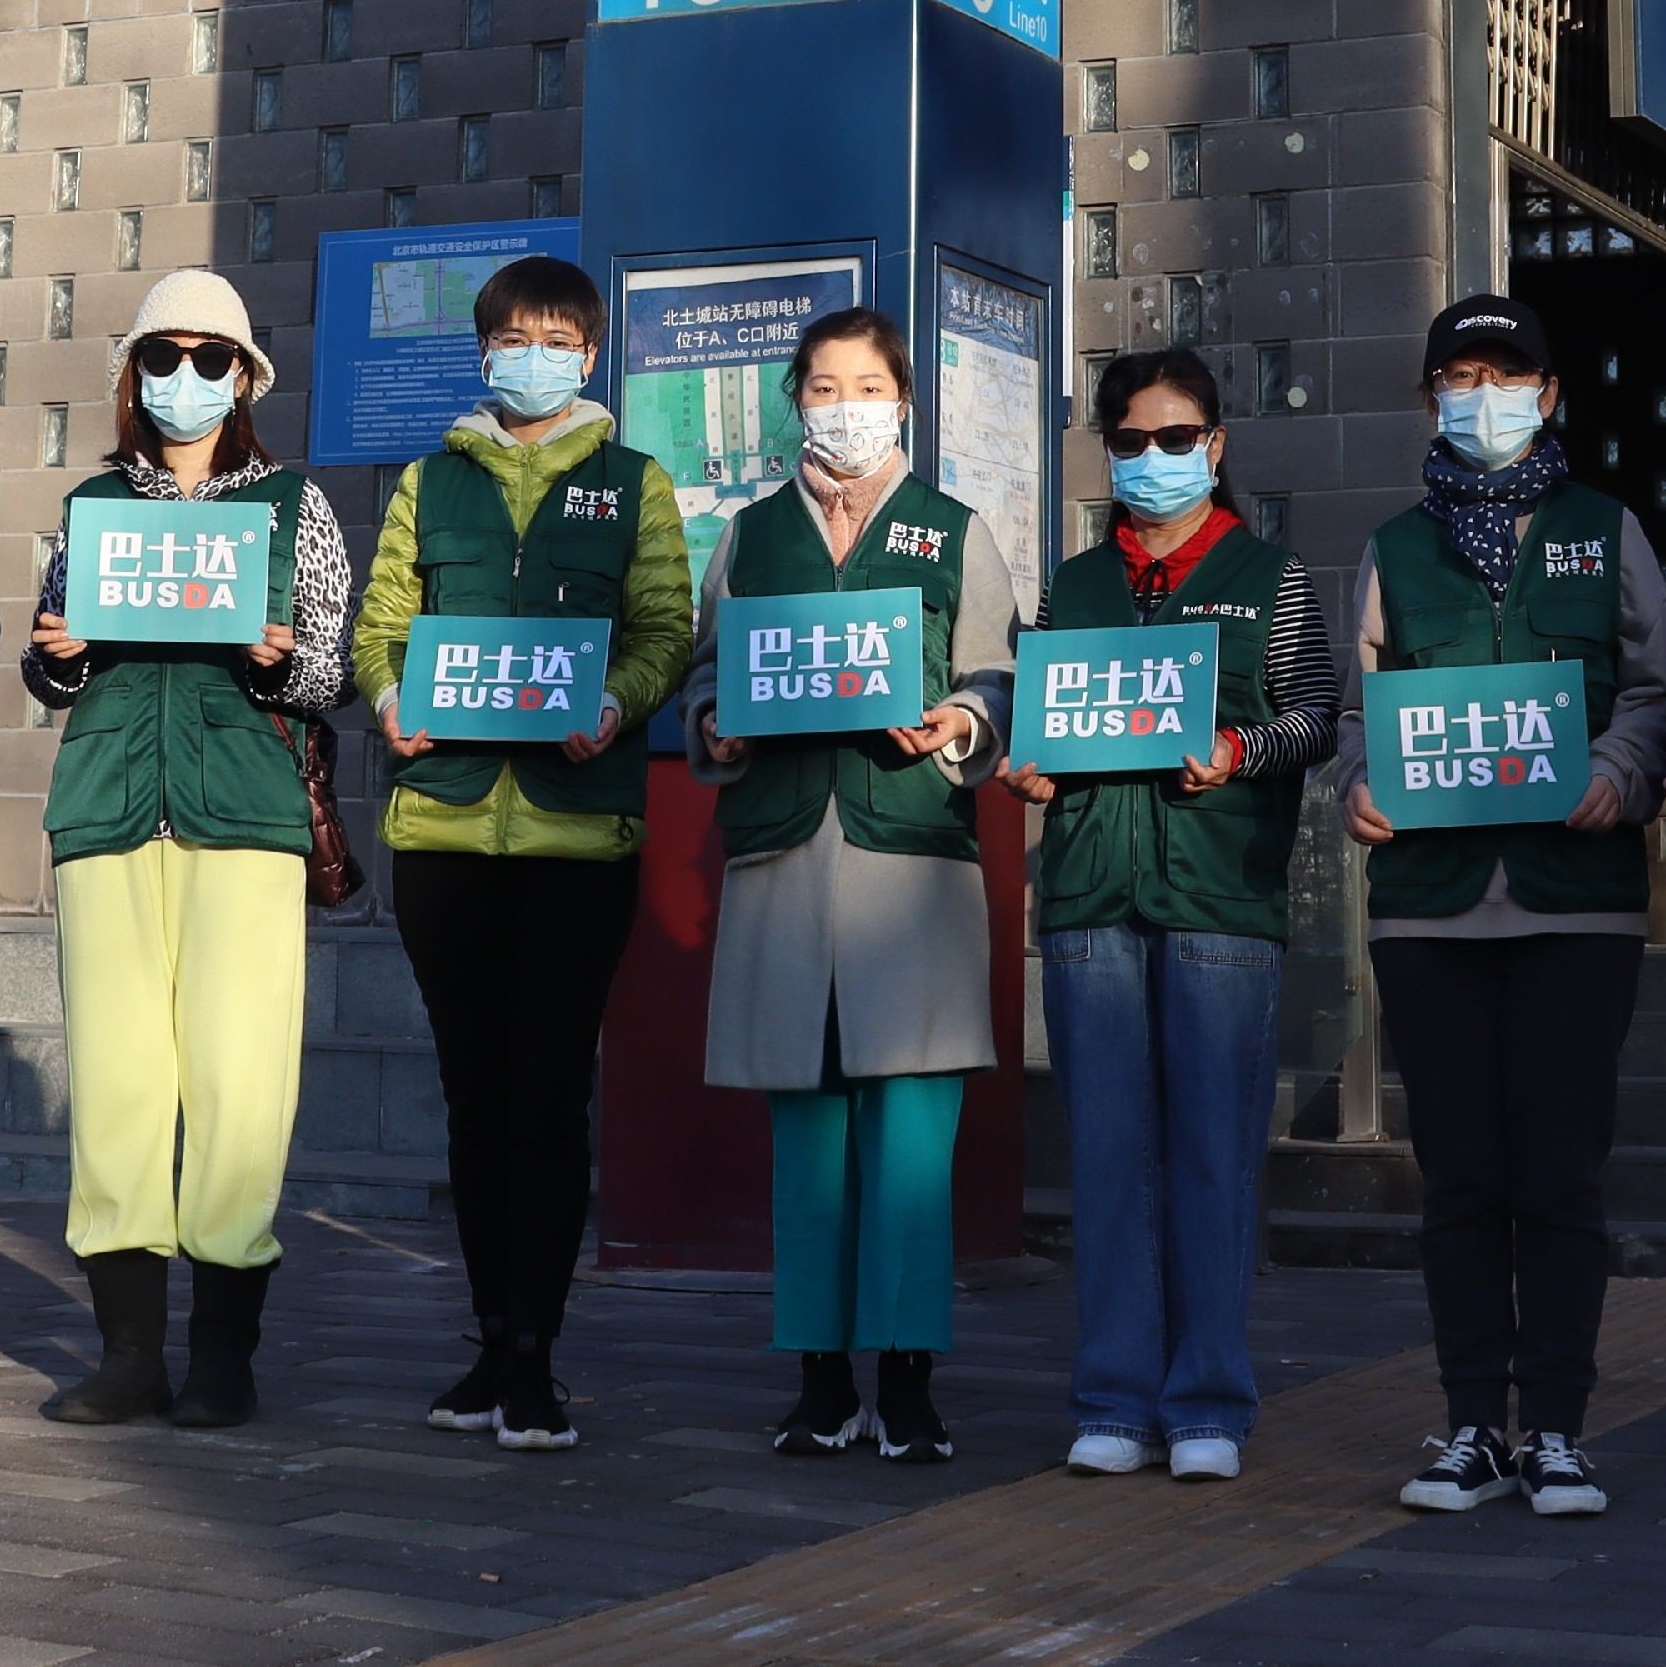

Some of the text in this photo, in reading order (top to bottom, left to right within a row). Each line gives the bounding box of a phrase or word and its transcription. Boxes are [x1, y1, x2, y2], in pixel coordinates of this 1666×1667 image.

[662, 296, 812, 328] 北土城站无障碍电梯
[645, 354, 688, 366] Elevators
[690, 353, 706, 363] are
[708, 348, 749, 362] available
[751, 349, 761, 358] at
[566, 486, 618, 505] 巴士达
[889, 521, 943, 547] 巴士达
[1545, 540, 1604, 560] 巴士达
[98, 532, 238, 580] 巴士达
[98, 580, 237, 610] BUSDA
[749, 622, 891, 673] 巴士达
[434, 644, 575, 685] 巴士达
[433, 685, 571, 710] BUSDA
[750, 670, 892, 702] BUSDA
[1044, 657, 1185, 708] 巴士达
[1044, 707, 1183, 739] BUSDA
[1398, 700, 1555, 757] 巴士达
[1404, 754, 1558, 791] BUSDA
